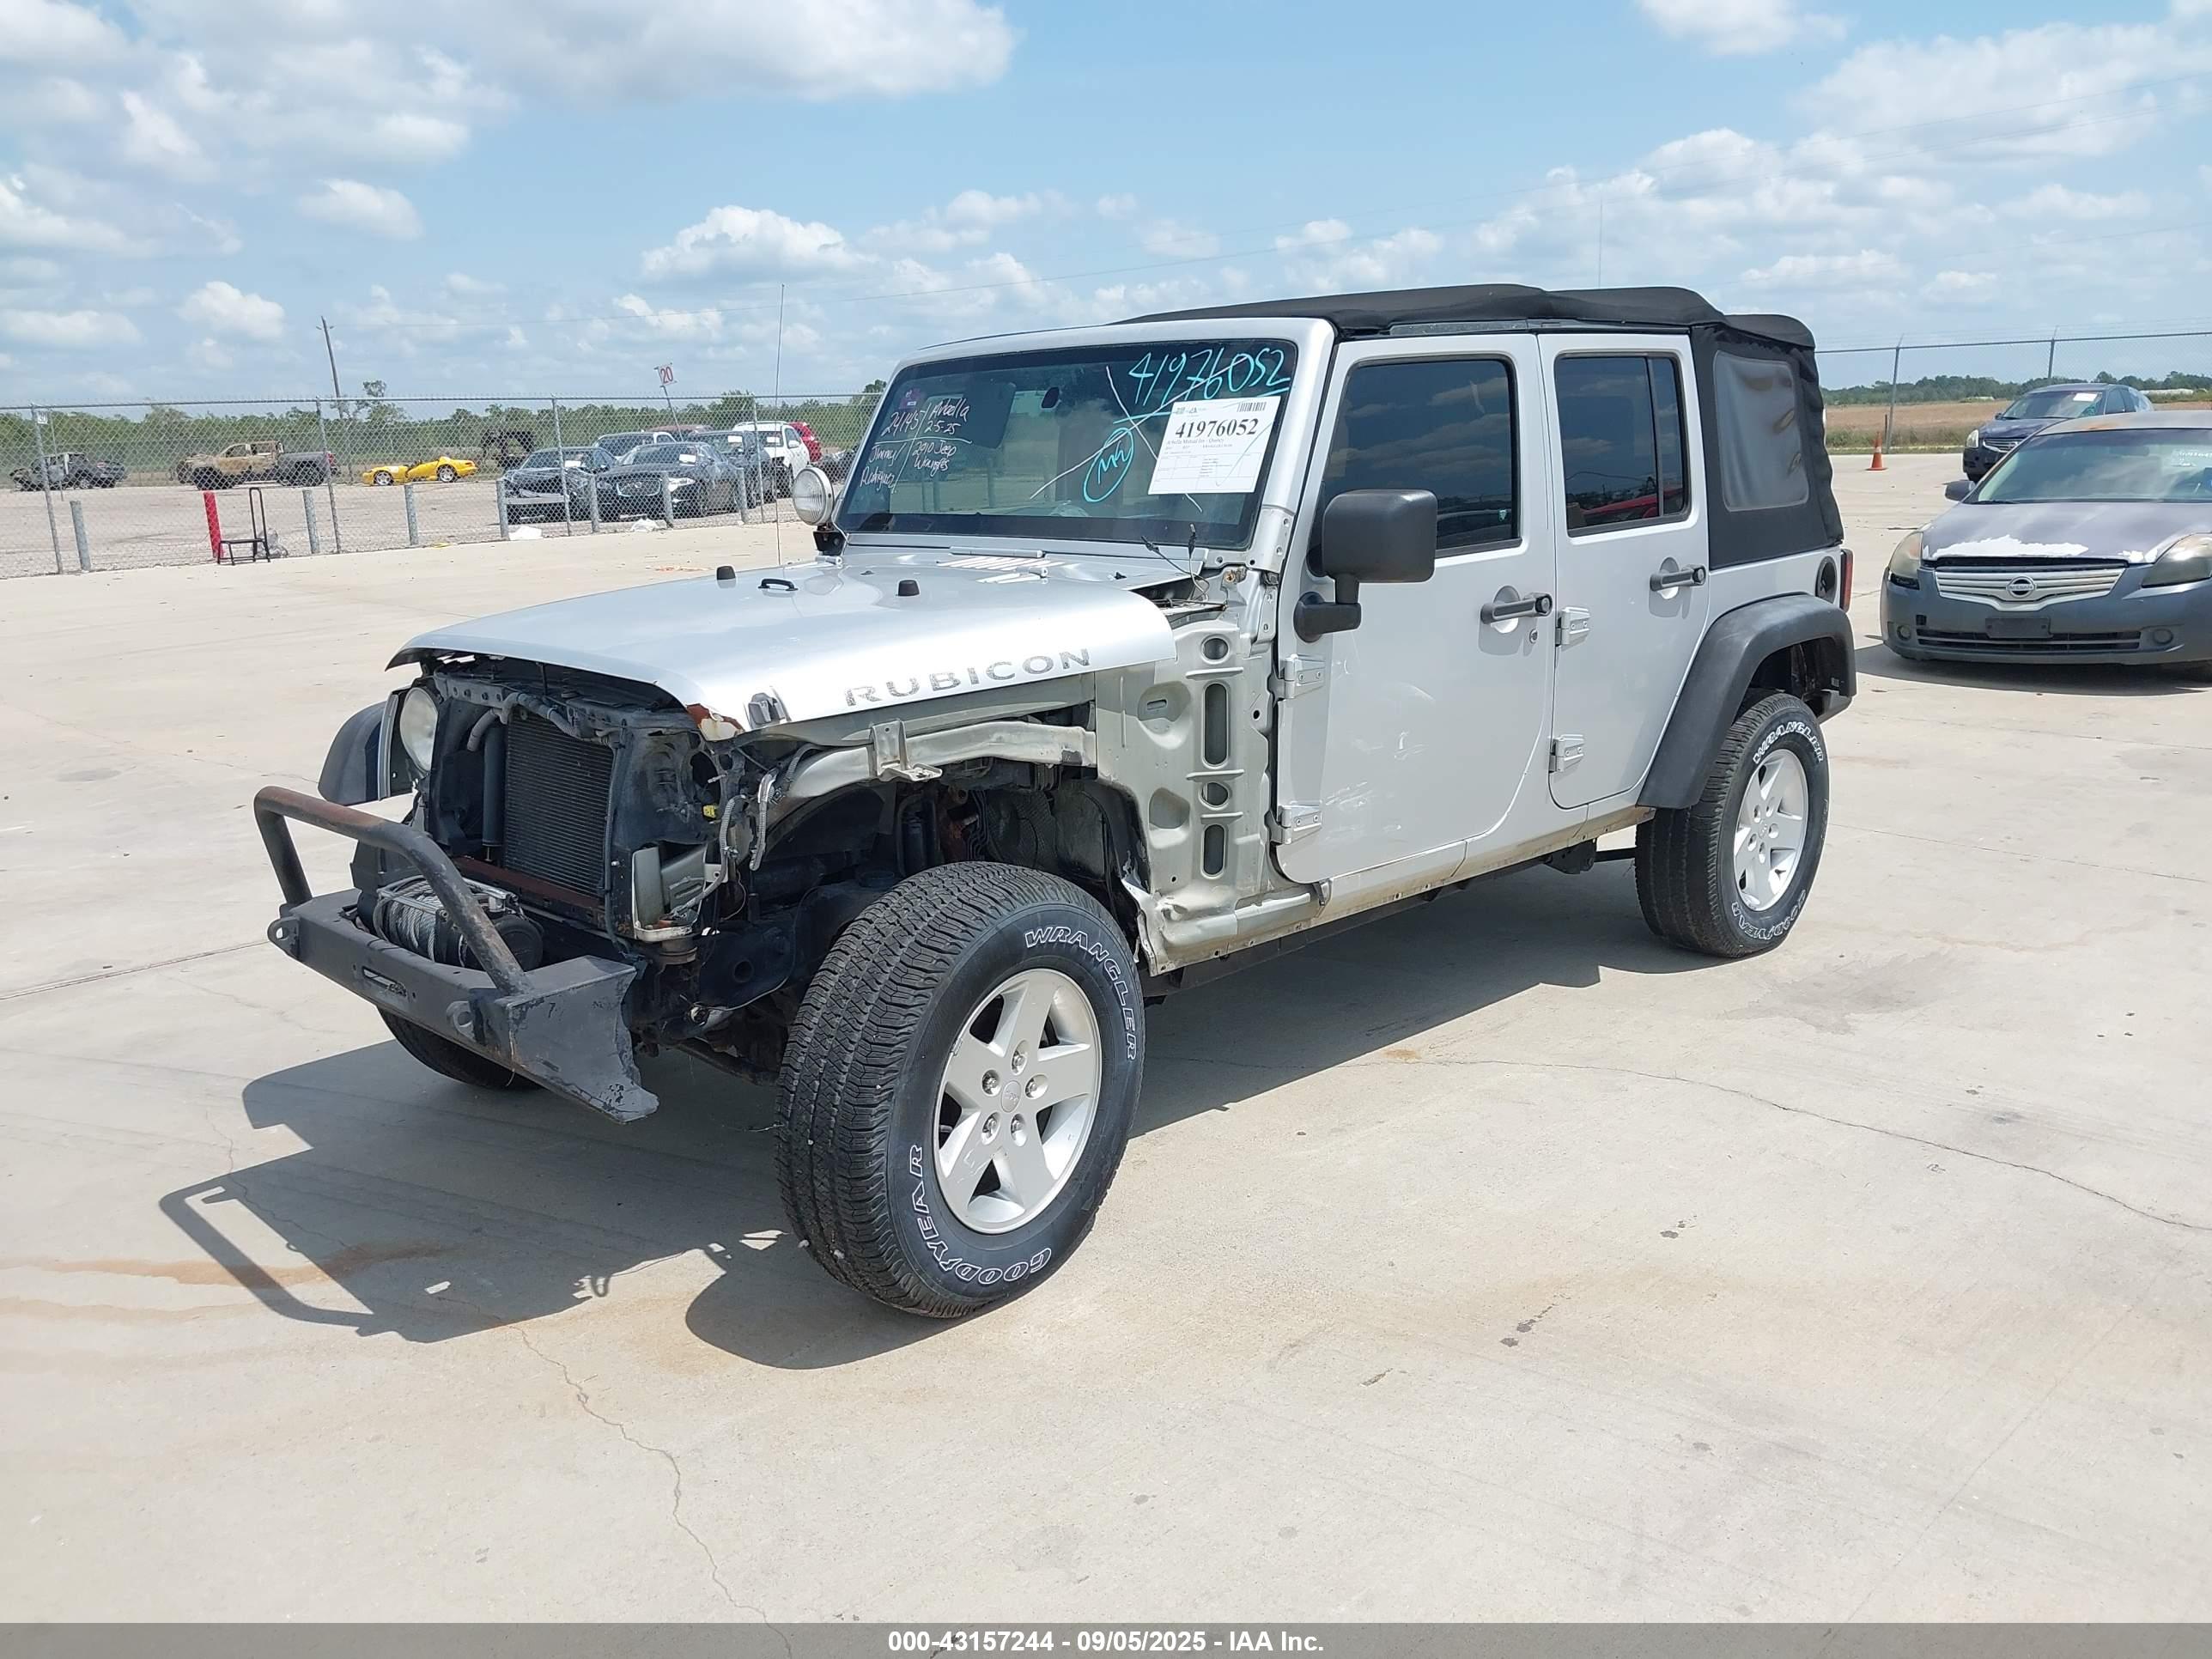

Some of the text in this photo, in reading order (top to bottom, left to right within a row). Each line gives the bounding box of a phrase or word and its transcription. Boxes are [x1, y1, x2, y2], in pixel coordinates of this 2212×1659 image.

[660, 366, 674, 384] 20
[1128, 347, 1291, 406] 41976052
[1175, 417, 1259, 439] 41976052
[843, 648, 1091, 707] RUBICON
[1753, 721, 1824, 764] WRANGLER
[1731, 889, 1807, 940] GOODYEAR
[1024, 926, 1137, 1061] WRANGLER
[909, 1145, 1052, 1285] GOODYEAR
